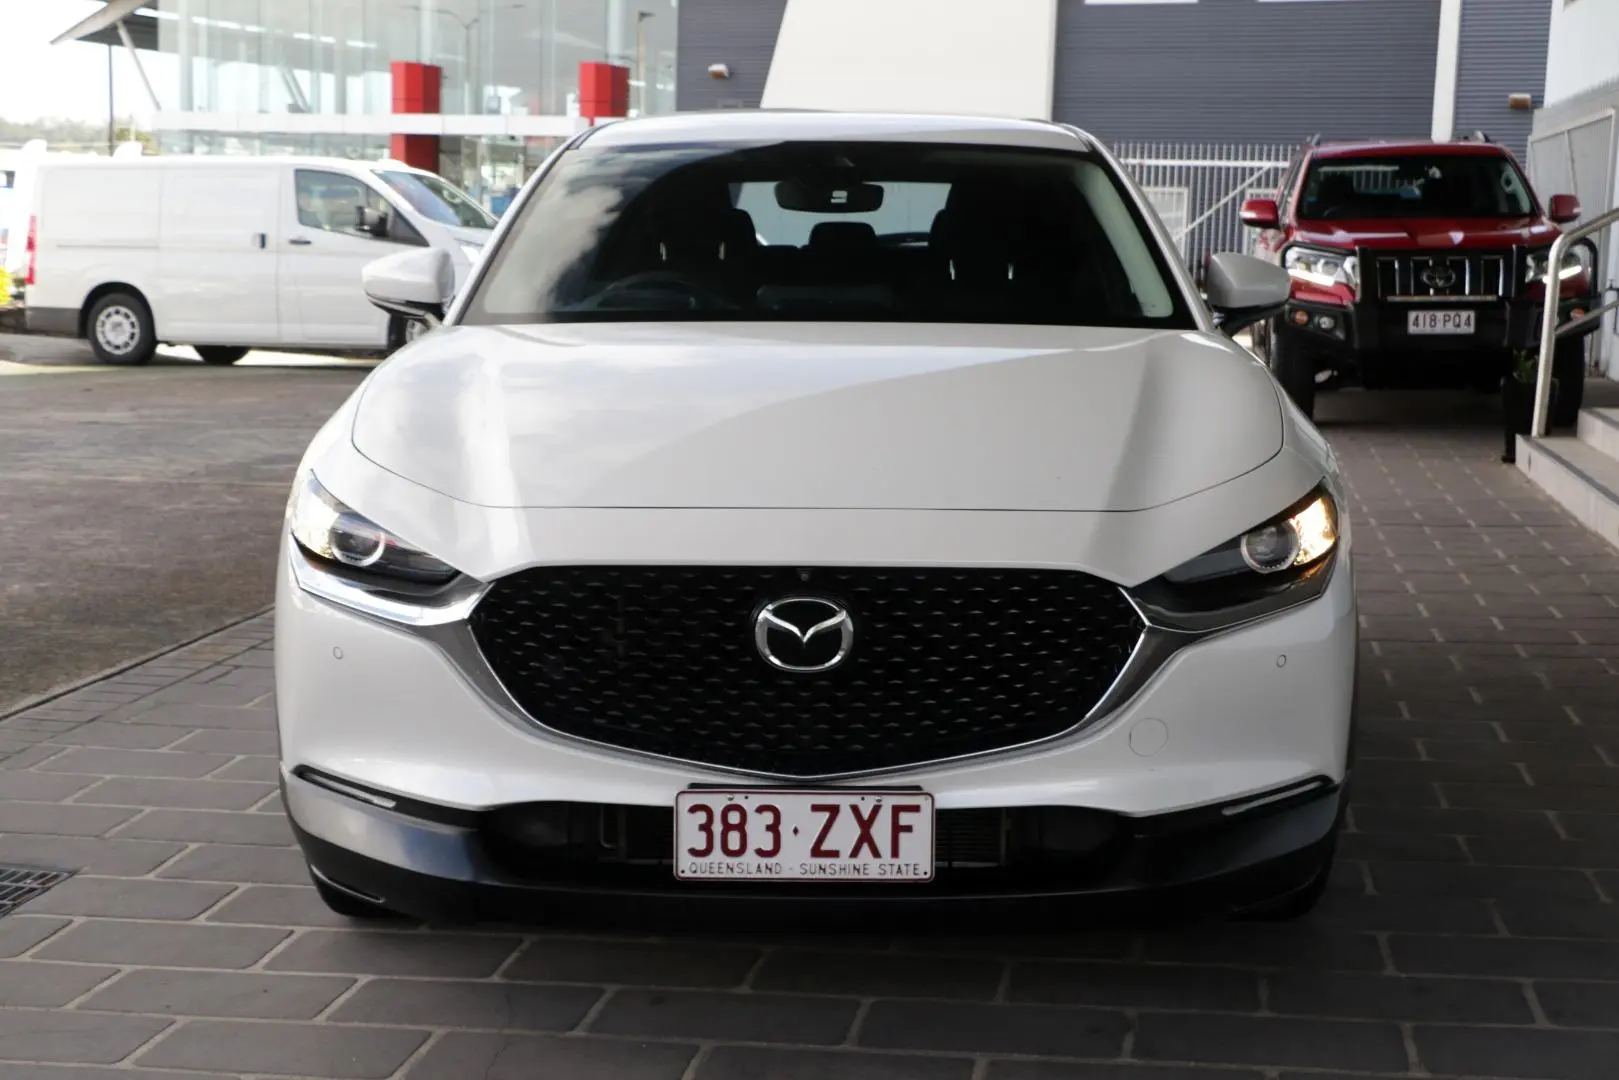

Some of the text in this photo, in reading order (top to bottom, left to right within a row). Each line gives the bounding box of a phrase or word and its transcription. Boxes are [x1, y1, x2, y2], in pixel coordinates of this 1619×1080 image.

[688, 862, 920, 877] QUEENSLAND SUNSHINE STATE
